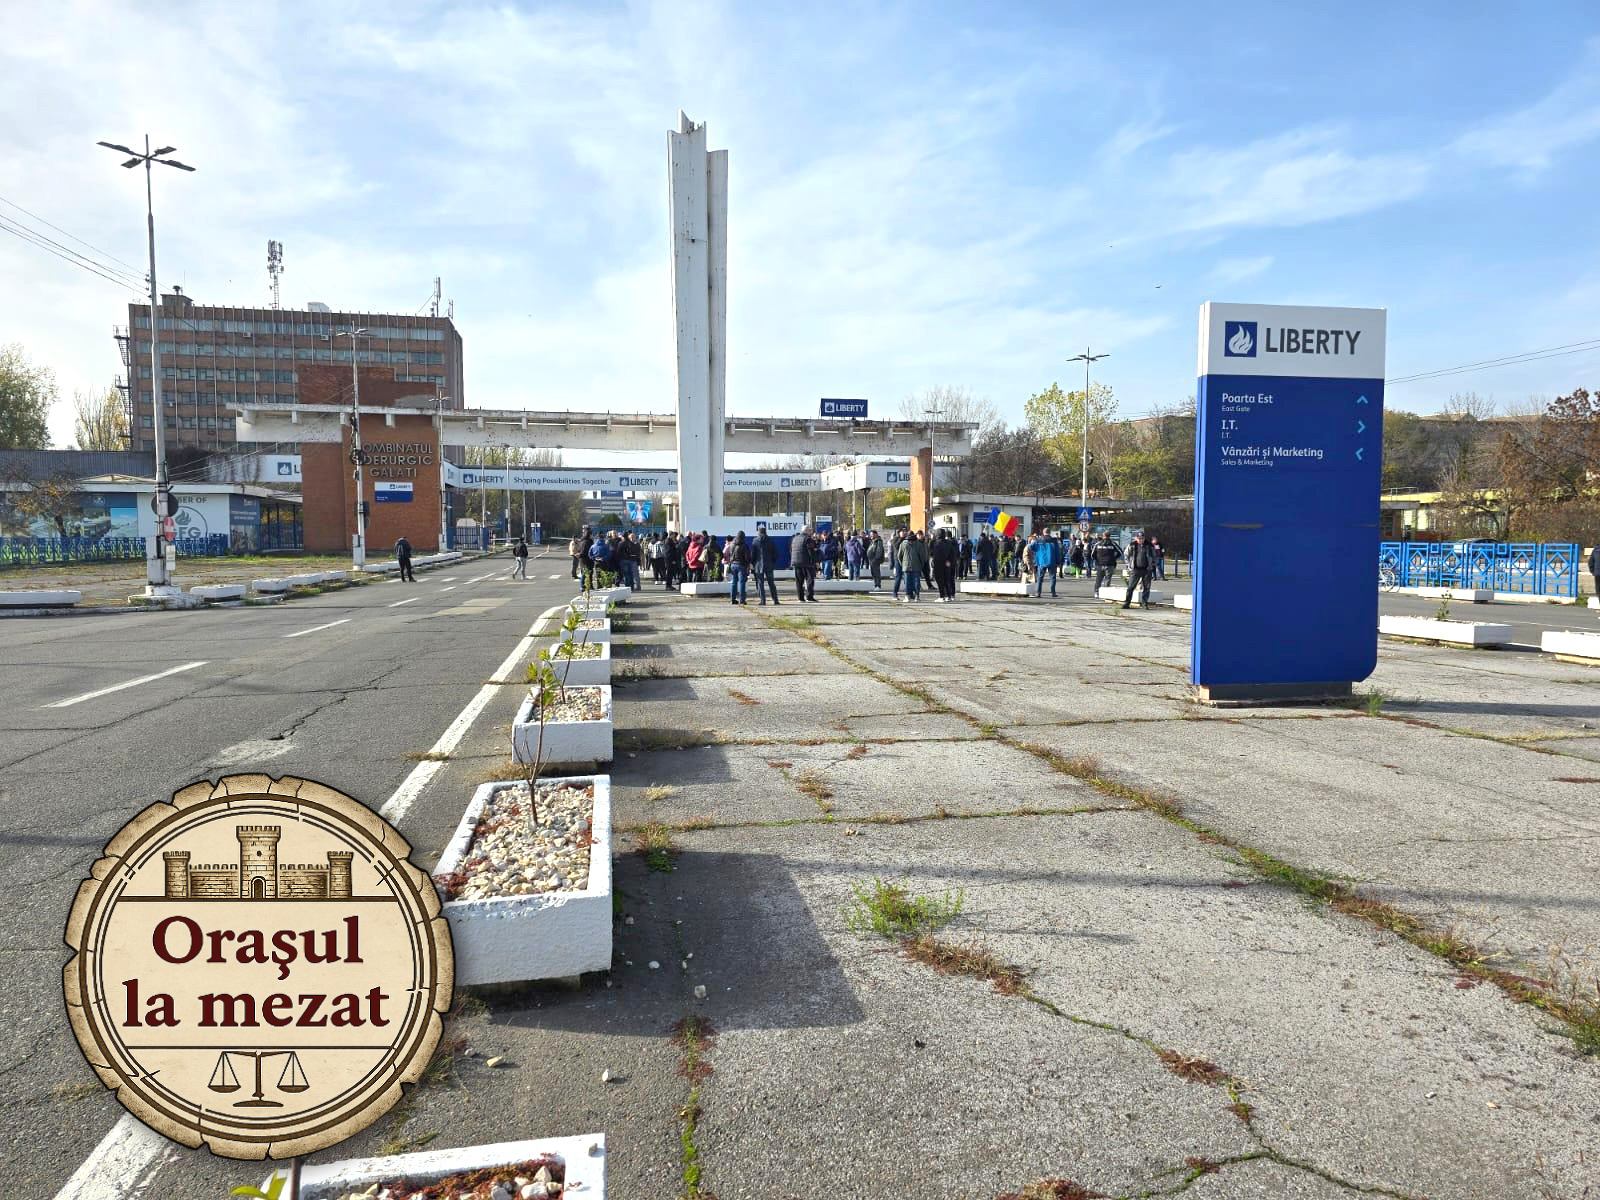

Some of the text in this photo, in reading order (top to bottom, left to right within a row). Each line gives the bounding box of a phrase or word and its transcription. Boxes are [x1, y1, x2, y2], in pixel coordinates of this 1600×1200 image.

[1265, 327, 1361, 355] LIBERTY
[1222, 393, 1273, 404] Poarta Est
[836, 403, 864, 412] LIBERTY
[1221, 419, 1238, 430] I.T.
[361, 443, 433, 454] OMBINATUL
[1221, 446, 1260, 456] Vânzări
[1273, 447, 1324, 459] Marketing
[351, 455, 433, 465] SDERURGIC
[513, 477, 540, 485] Shaping
[582, 478, 611, 486] Together
[630, 478, 659, 486] LIBERTY
[791, 479, 817, 487] LIBERTY
[768, 522, 798, 531] LIBERTY
